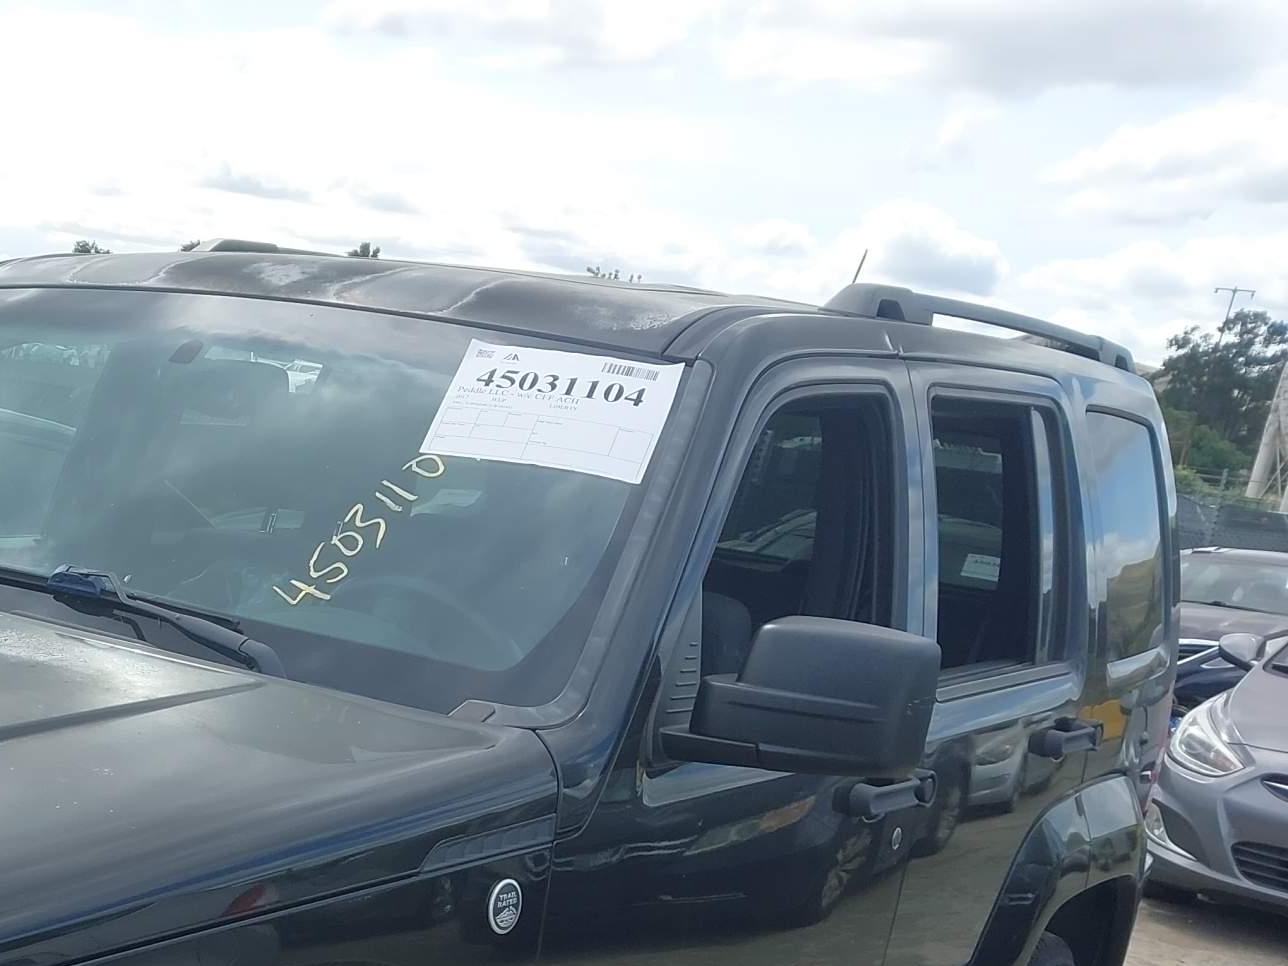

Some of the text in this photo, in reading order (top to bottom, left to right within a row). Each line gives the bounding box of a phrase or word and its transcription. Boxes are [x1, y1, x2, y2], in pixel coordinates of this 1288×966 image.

[476, 368, 647, 407] 45031104
[498, 891, 517, 901] TRAIL
[496, 898, 518, 908] RATED
